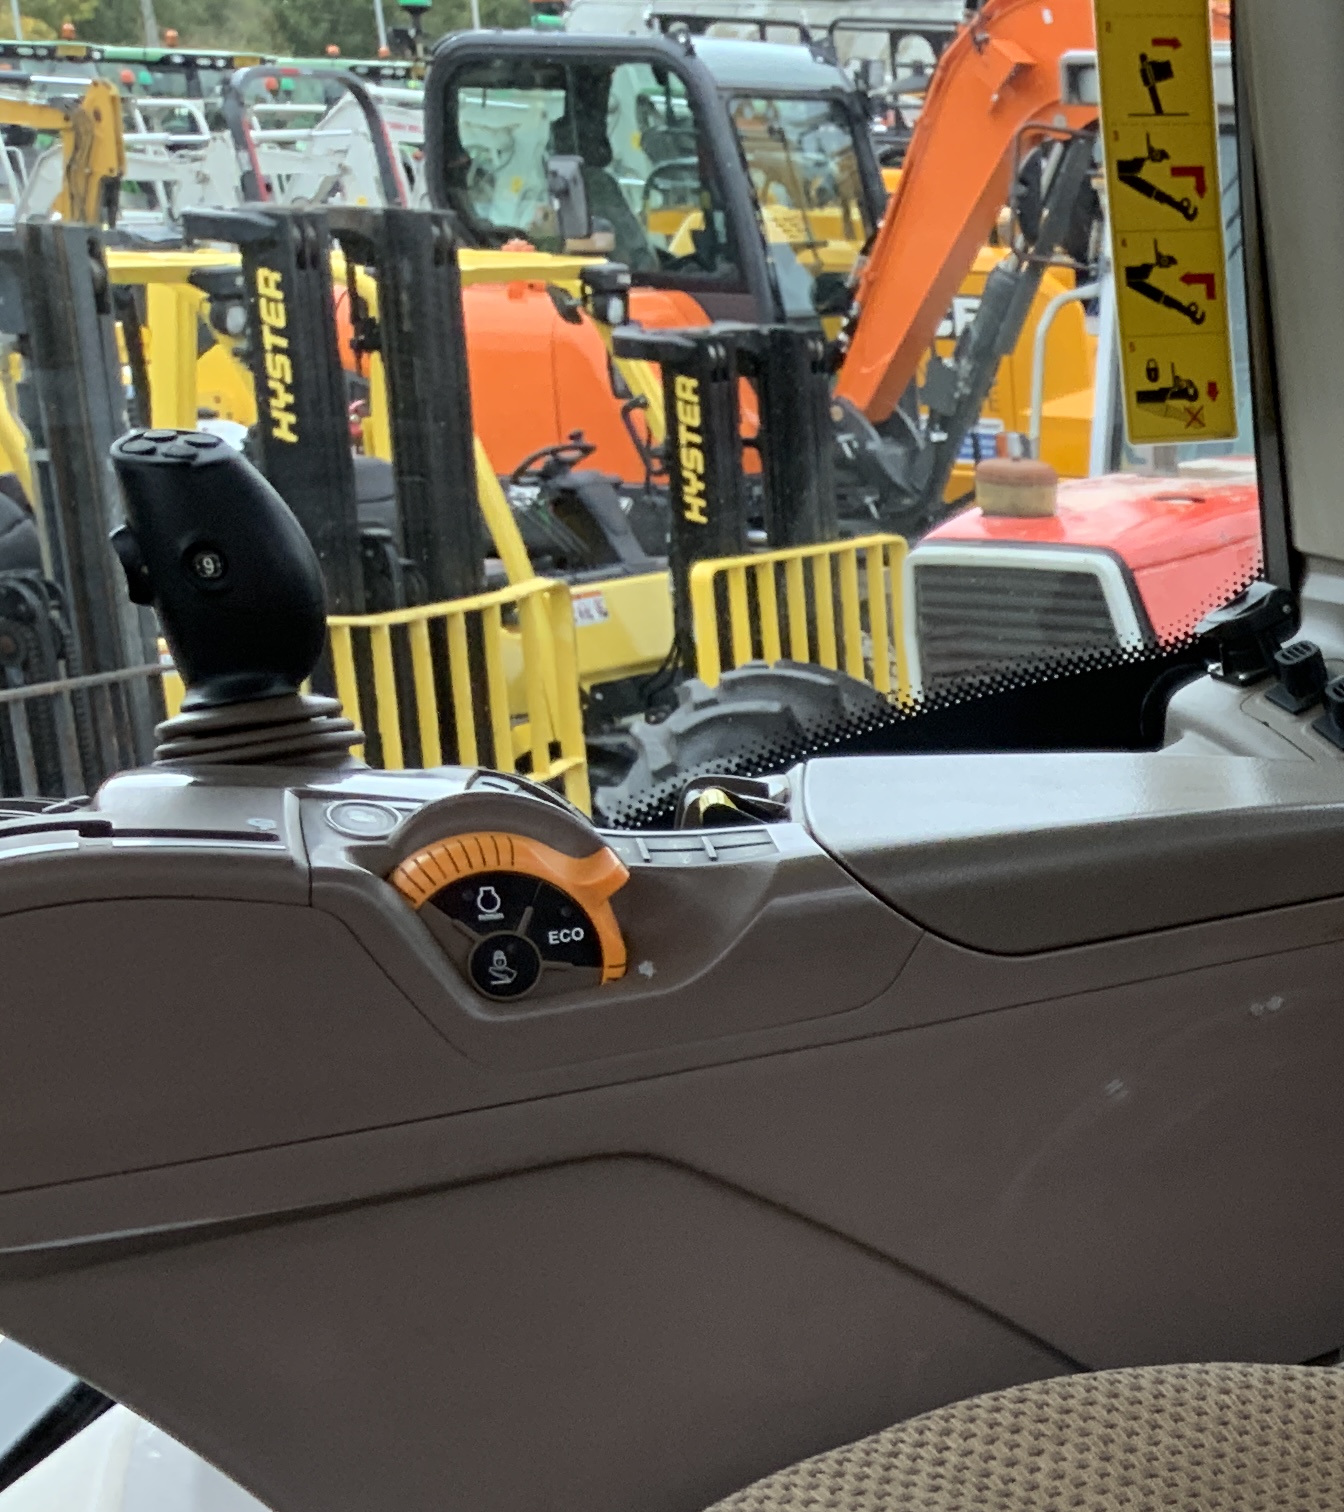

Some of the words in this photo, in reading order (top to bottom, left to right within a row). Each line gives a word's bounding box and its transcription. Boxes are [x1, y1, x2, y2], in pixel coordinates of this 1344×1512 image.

[256, 267, 300, 443] HYSTER
[675, 373, 709, 525] HYSTER
[202, 557, 215, 574] 9
[548, 927, 584, 945] ECO
